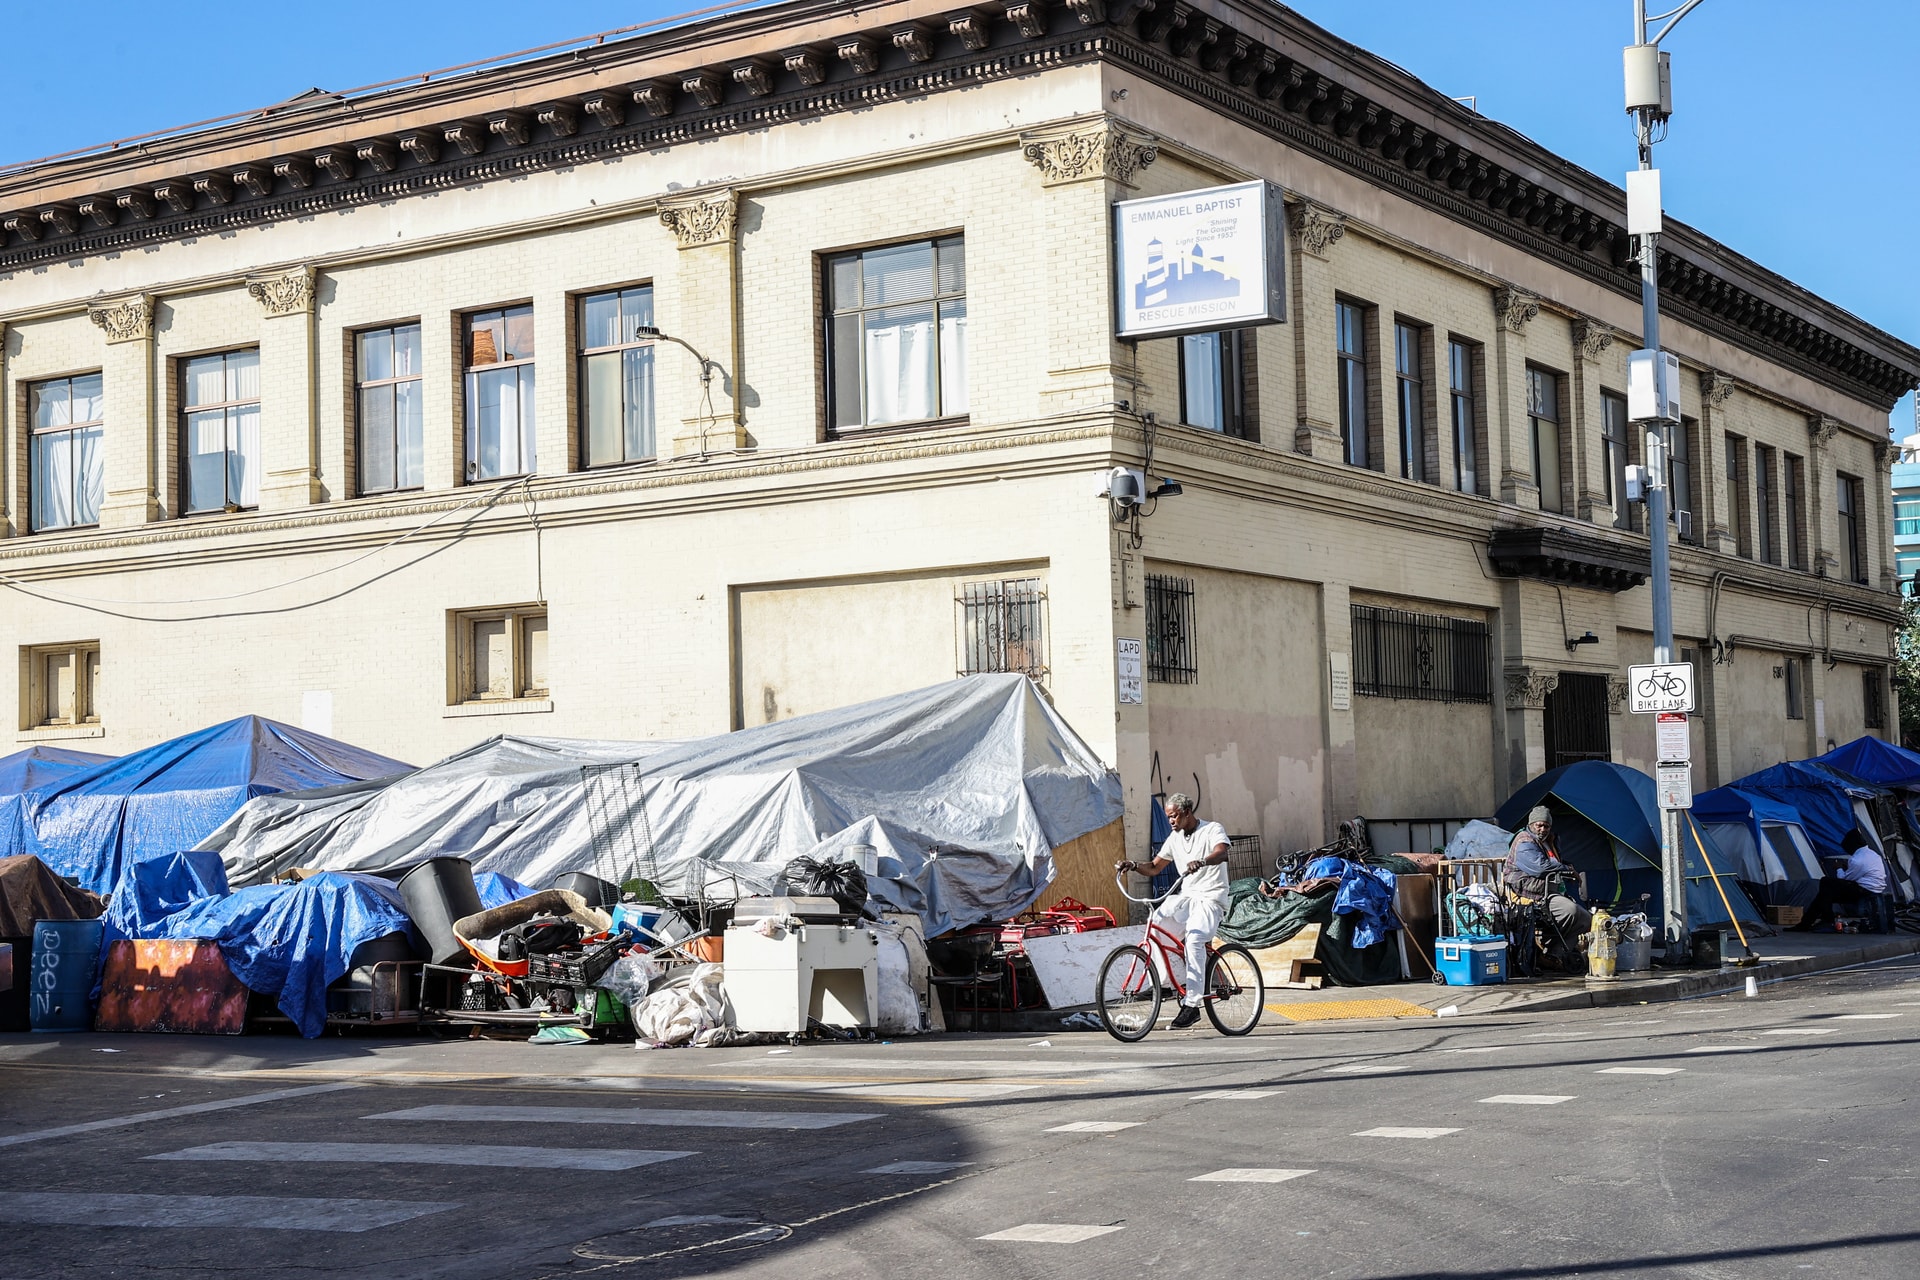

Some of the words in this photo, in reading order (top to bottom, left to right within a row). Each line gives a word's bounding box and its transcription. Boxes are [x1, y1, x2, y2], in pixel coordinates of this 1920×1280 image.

[1131, 206, 1192, 223] EMMANUEL
[1195, 197, 1242, 214] BAPTIST
[1196, 228, 1209, 236] The
[1210, 224, 1236, 234] Gospel
[1175, 238, 1194, 246] Light
[1196, 235, 1215, 243] Since
[1138, 307, 1185, 322] RESCUE
[1188, 300, 1236, 316] MISSION
[1119, 642, 1140, 654] LAPD
[1638, 700, 1658, 710] BIKE
[1662, 698, 1687, 709] LANE
